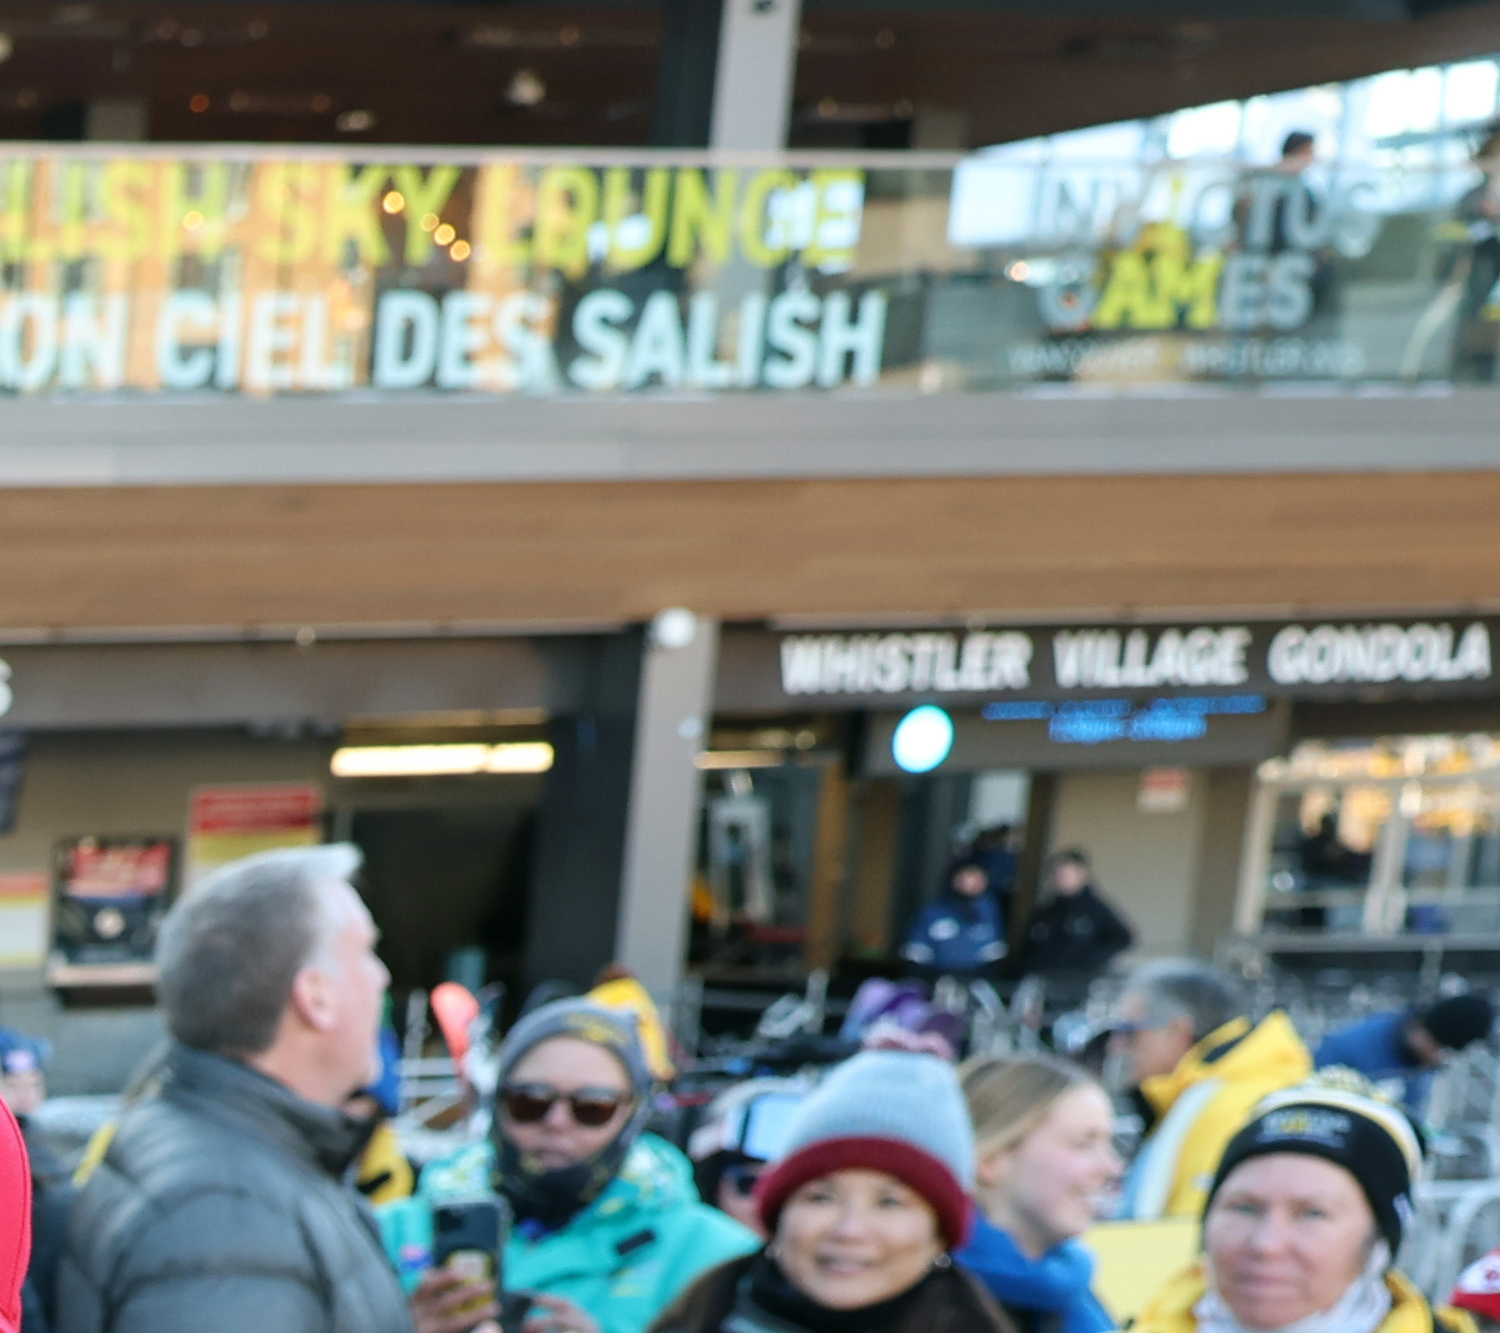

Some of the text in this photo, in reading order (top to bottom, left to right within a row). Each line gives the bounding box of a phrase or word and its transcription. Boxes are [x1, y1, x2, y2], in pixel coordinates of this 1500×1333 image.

[261, 160, 460, 266] SKY
[477, 163, 863, 273] LOUNGE
[1038, 248, 1317, 330] GAMES
[155, 288, 356, 391] CIEL
[374, 288, 551, 391] DES
[568, 288, 887, 391] SALISH
[781, 622, 1493, 694] WHISTLER VILLAGE GONDOLA
